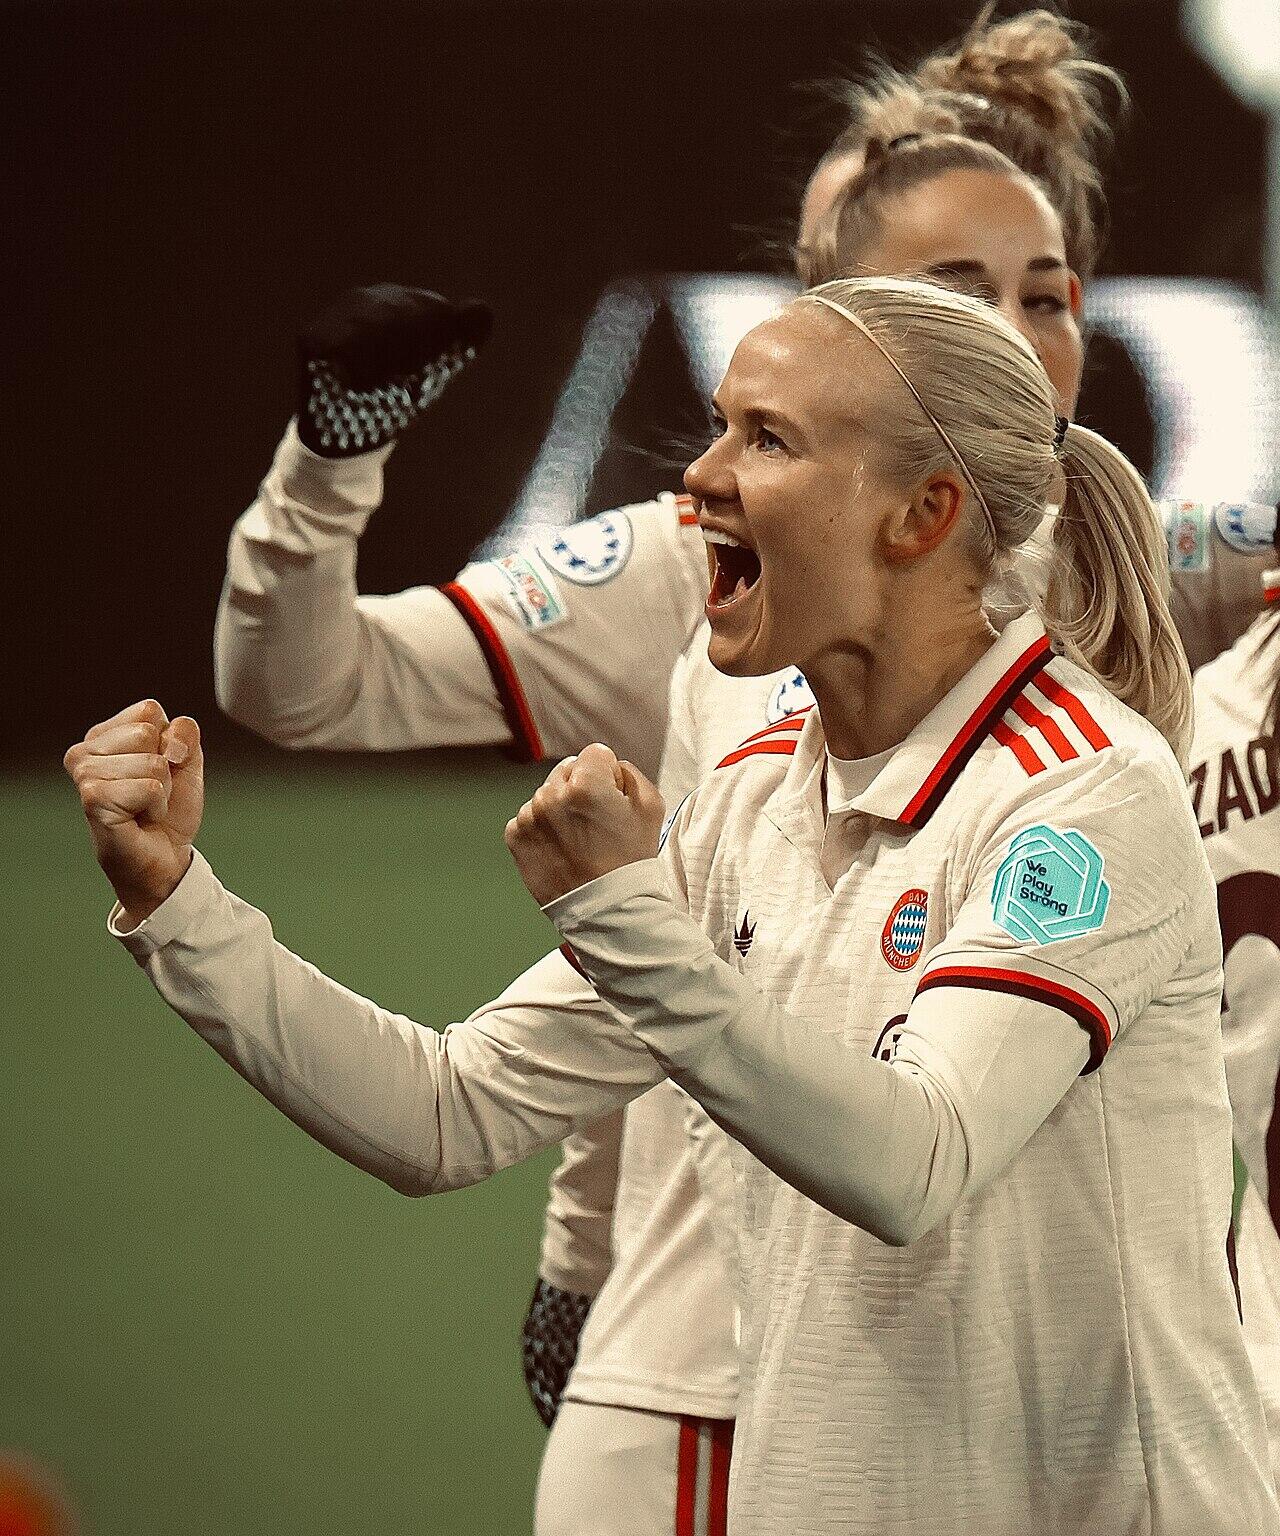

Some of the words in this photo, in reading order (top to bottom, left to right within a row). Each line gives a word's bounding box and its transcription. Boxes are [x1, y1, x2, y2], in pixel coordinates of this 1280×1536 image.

[1025, 859, 1047, 876] We
[1022, 873, 1054, 897] Play
[1020, 887, 1068, 916] Strong
